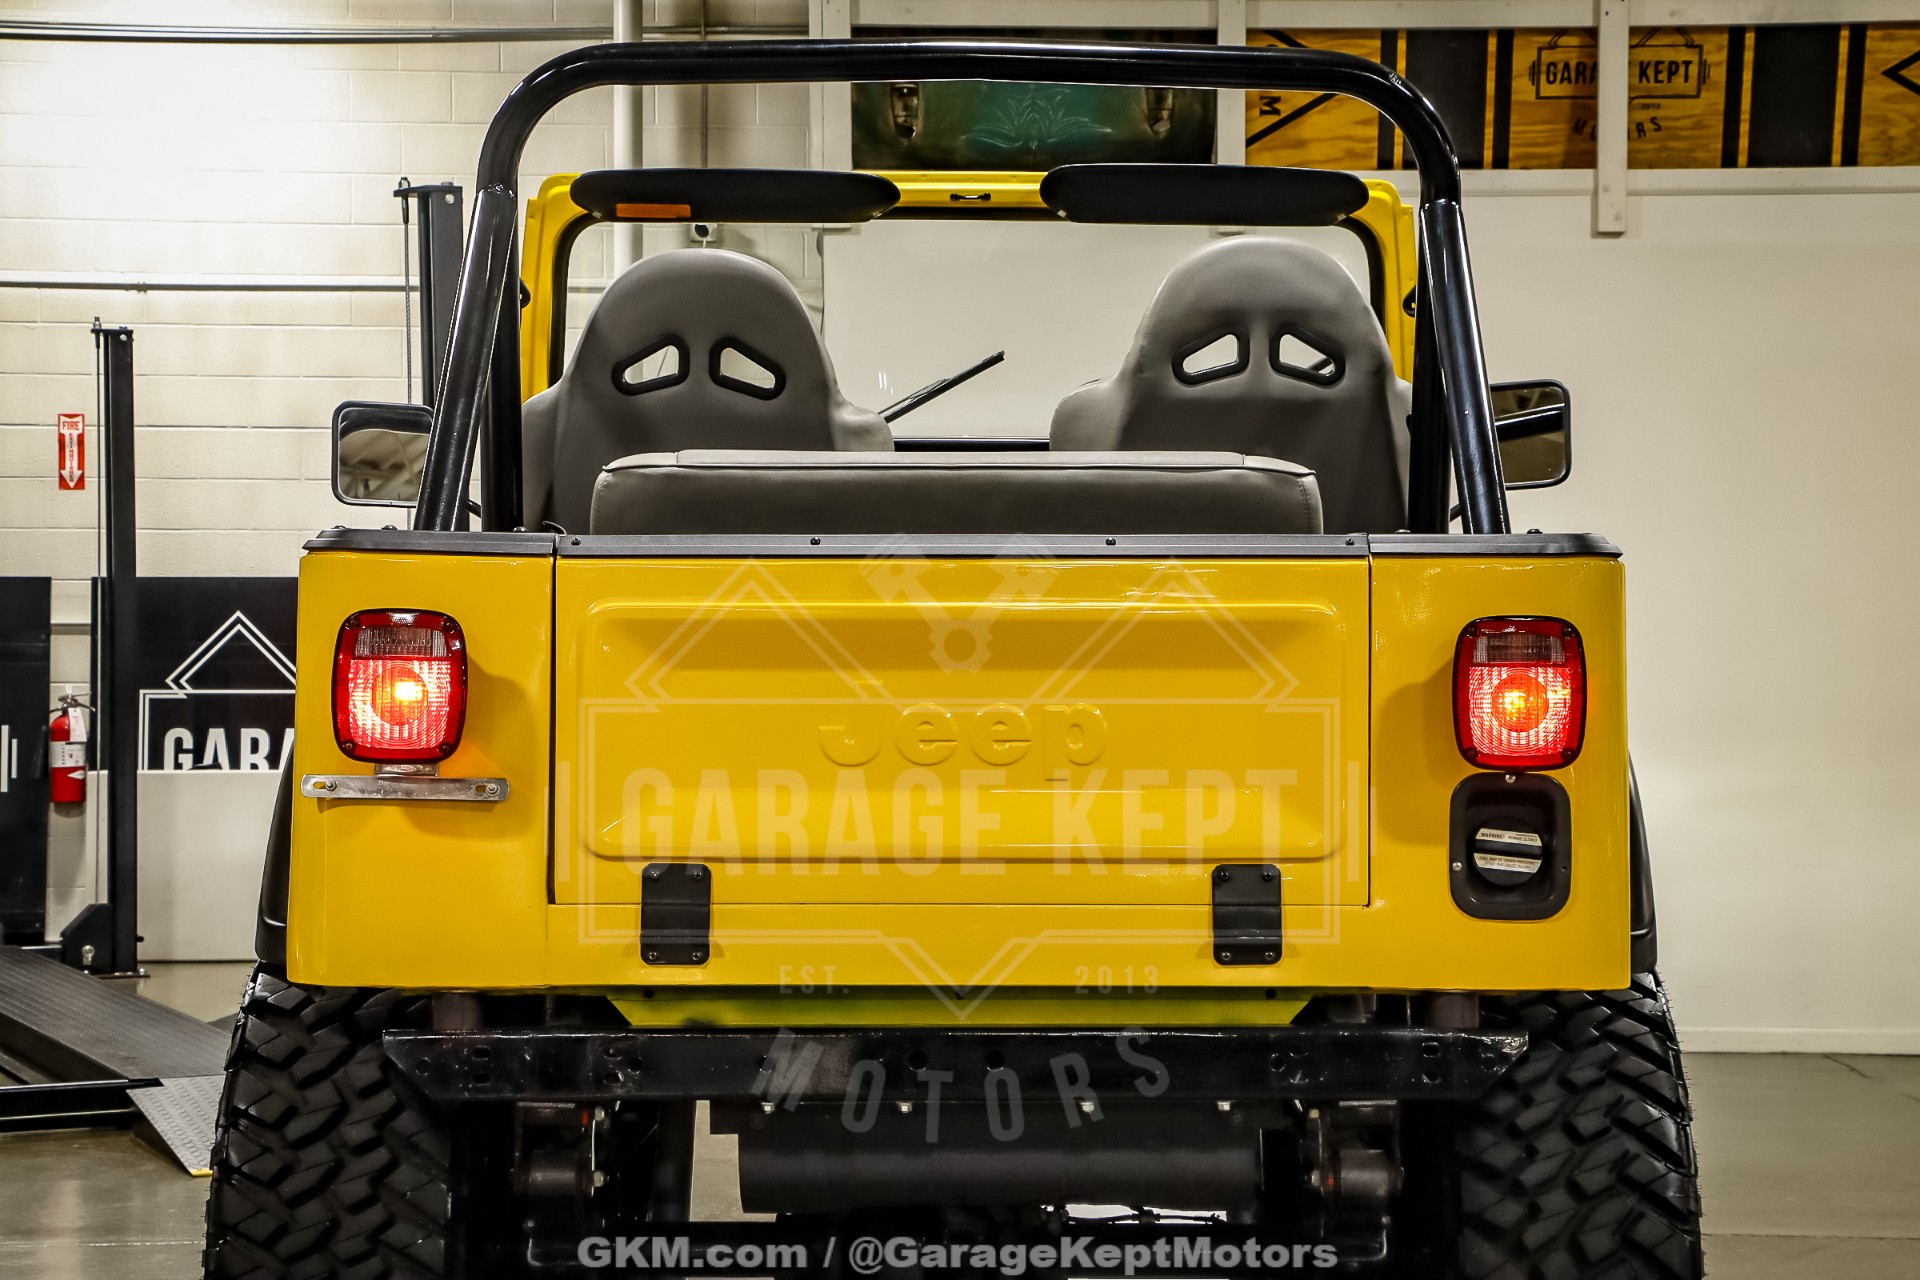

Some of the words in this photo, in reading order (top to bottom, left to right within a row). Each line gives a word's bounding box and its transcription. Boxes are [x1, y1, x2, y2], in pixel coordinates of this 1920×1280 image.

[1638, 60, 1693, 84] KEPT
[62, 420, 80, 430] FIRE
[818, 679, 1108, 782] Jeep
